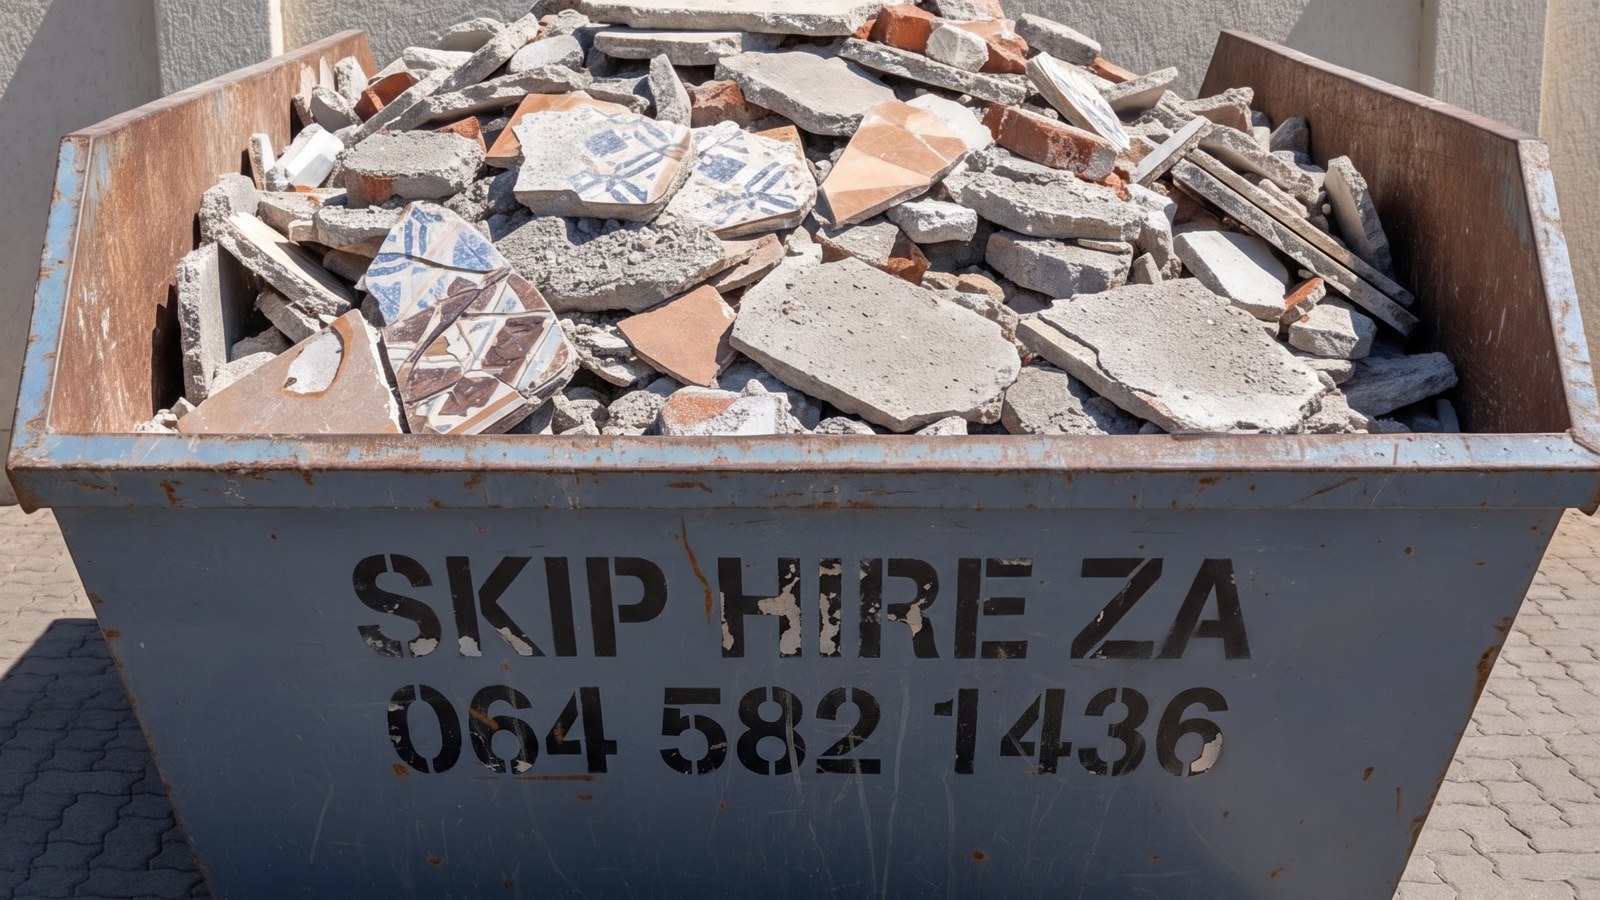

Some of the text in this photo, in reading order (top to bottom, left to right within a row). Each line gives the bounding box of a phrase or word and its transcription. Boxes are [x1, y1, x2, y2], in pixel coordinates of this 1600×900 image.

[352, 553, 1252, 660] SKIP HIRE ZA
[387, 684, 1229, 777] 064 582 1436
